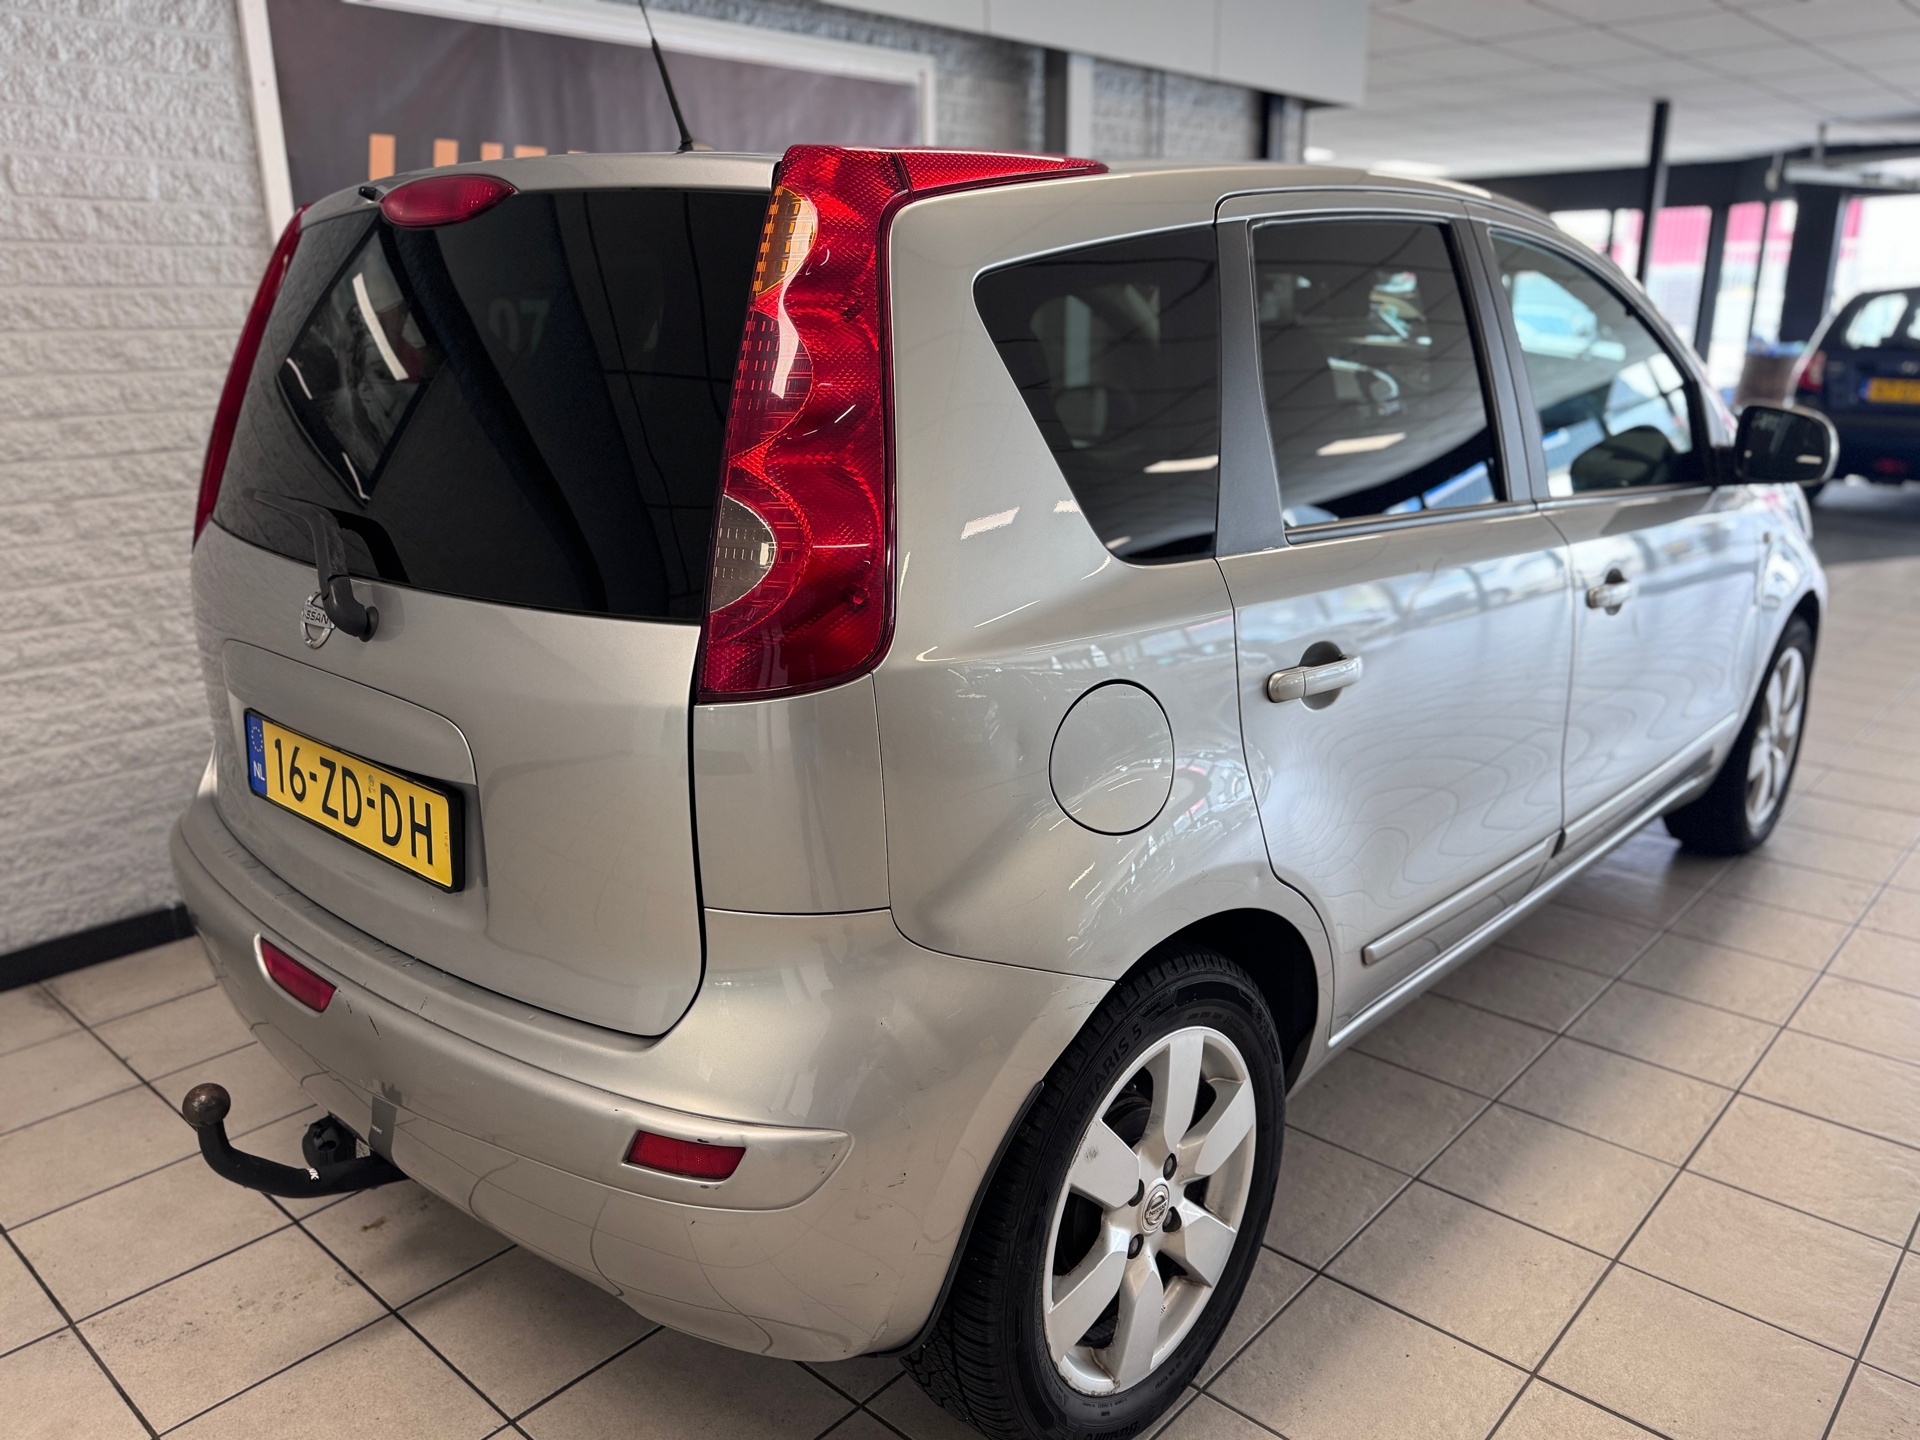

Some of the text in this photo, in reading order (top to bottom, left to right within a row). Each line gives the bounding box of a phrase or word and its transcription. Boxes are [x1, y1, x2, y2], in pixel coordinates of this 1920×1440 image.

[253, 760, 266, 781] NL
[274, 738, 433, 866] 16-ZD-DH
[1131, 1022, 1143, 1042] 5
